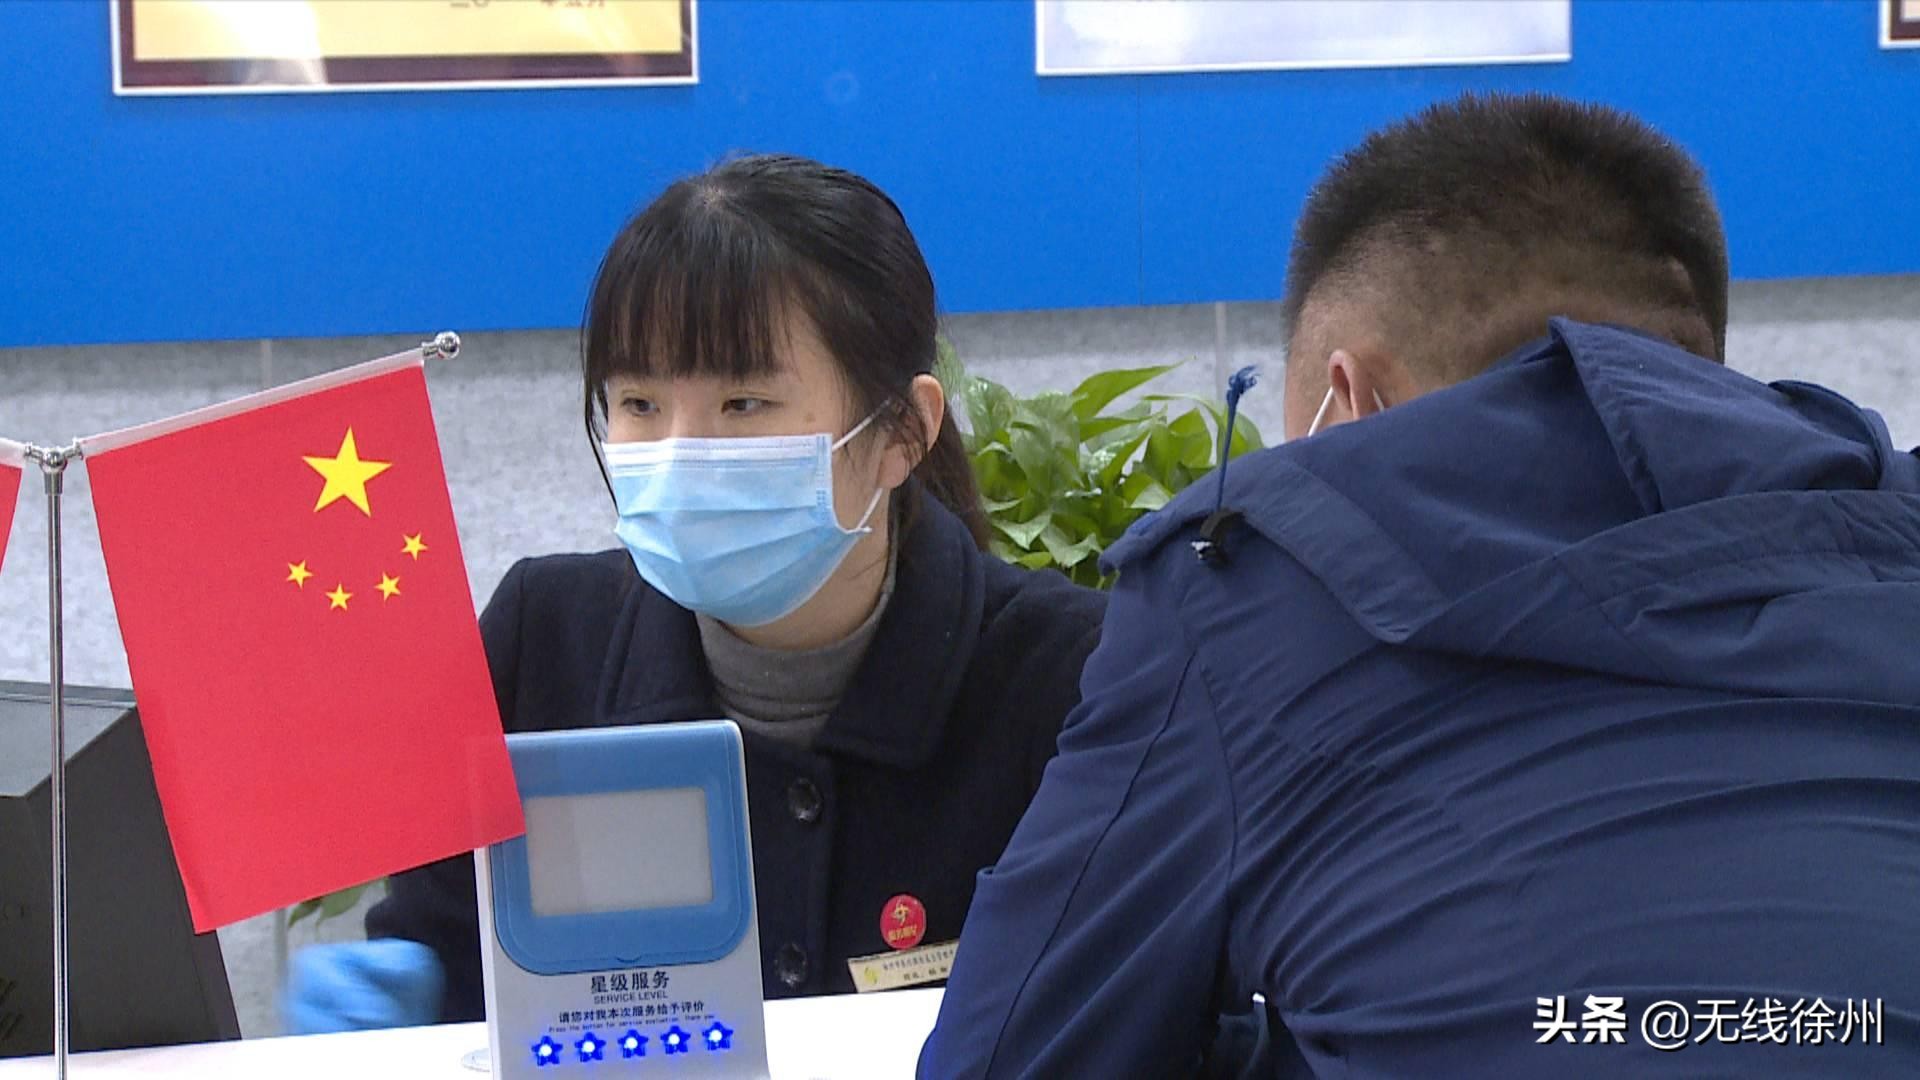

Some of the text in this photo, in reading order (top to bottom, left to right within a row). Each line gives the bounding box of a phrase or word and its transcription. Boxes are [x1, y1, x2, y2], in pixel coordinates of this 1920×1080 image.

[591, 970, 670, 994] 星级服务
[594, 990, 669, 1005] SERVICE LEVEL
[559, 1000, 705, 1023] 请您对我本次服务给予评价
